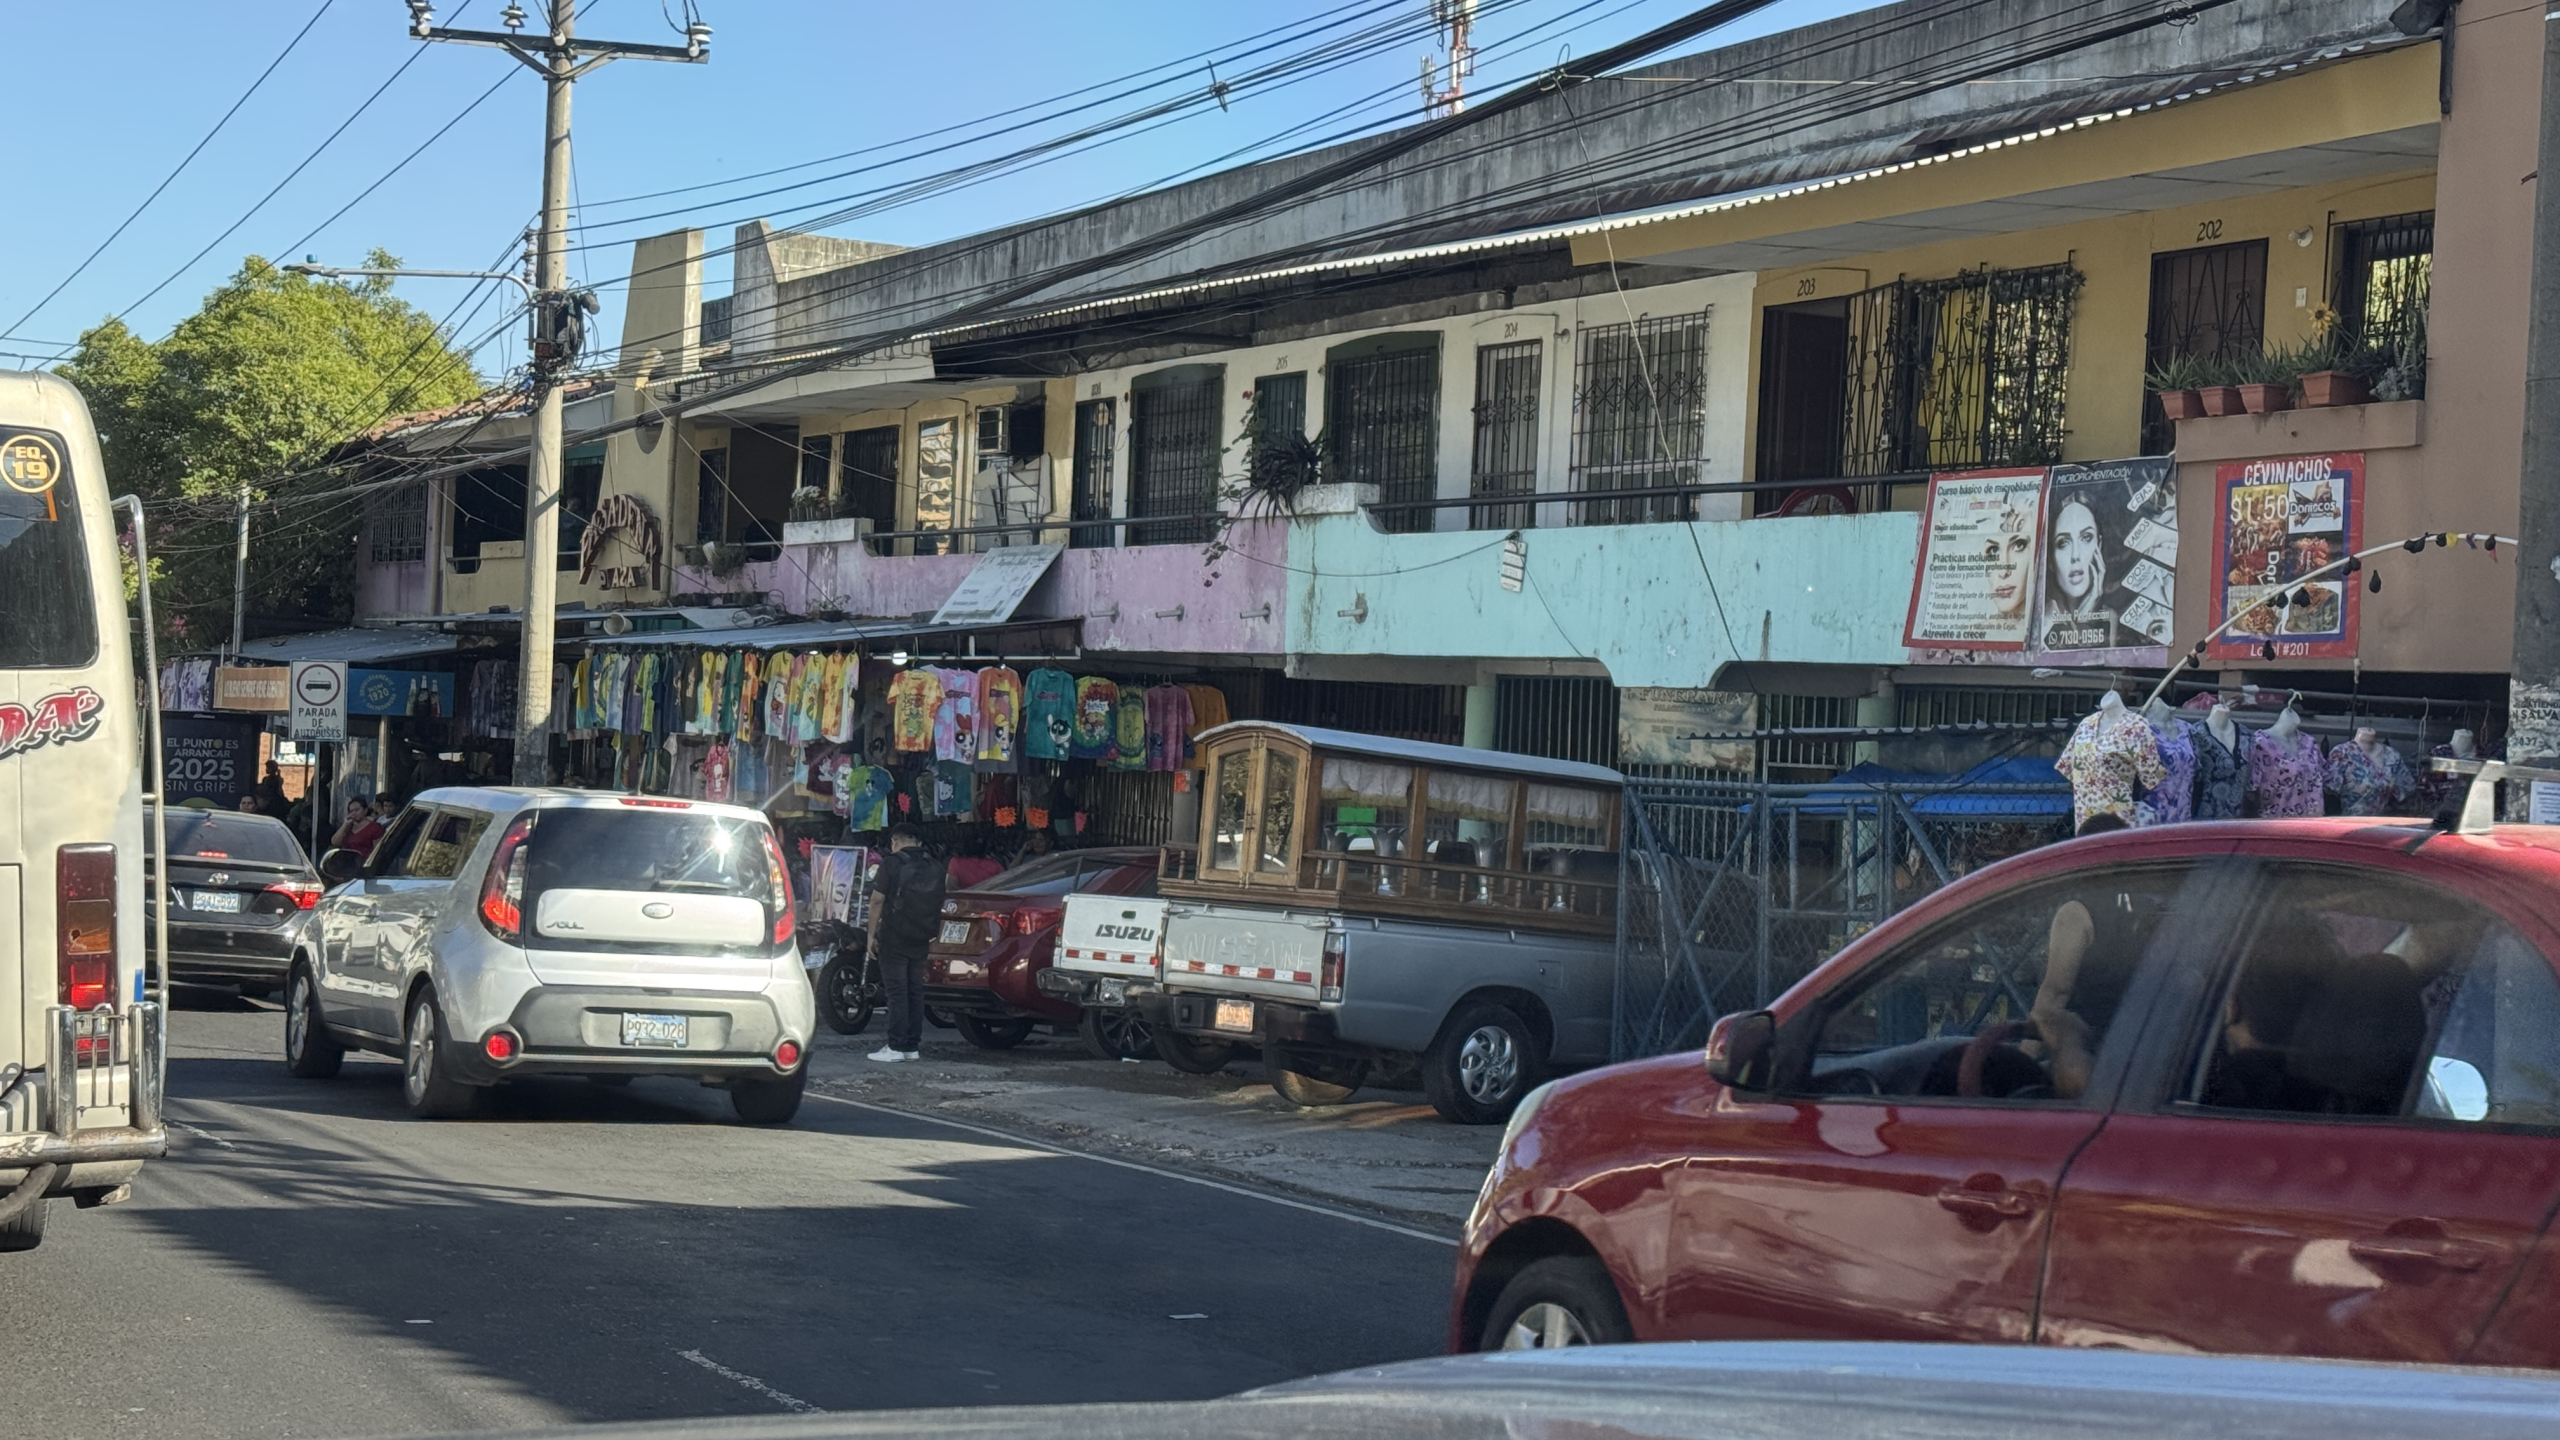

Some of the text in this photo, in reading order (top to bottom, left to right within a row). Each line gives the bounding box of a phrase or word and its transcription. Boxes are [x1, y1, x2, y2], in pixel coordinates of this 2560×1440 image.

[2196, 218, 2223, 243] 202
[1797, 277, 1816, 297] 203
[1504, 321, 1519, 339] 204
[15, 446, 47, 459] EQ.
[12, 461, 48, 479] 19
[1937, 481, 2041, 496] Curso básico de microblading
[2130, 484, 2153, 510] CEJAS
[2230, 494, 2289, 525] $1.50
[2127, 519, 2151, 548] LABIOS
[1933, 553, 2000, 563] Prácticas incluidas
[1929, 563, 1947, 572] Centro
[1948, 563, 1956, 571] de
[2126, 562, 2146, 585] OJOS
[2123, 598, 2146, 624] CEJAS
[1963, 630, 1987, 639] crecer
[2060, 628, 2105, 645] 7130-0966
[2251, 642, 2310, 656] Lol #201
[1640, 688, 1742, 705] FUNERARIA
[298, 707, 338, 718] PARADA
[311, 718, 323, 728] DE
[294, 728, 342, 739] AUTOBUSES
[166, 738, 180, 747] EL
[225, 740, 239, 749] ES
[174, 748, 231, 758] ARRANCAR
[167, 758, 235, 780] 2025
[165, 780, 236, 793] SIN GRIPE
[1095, 923, 1154, 942] ISUZU
[1184, 931, 1302, 971] NISSAN
[626, 1019, 685, 1039] P932-028
